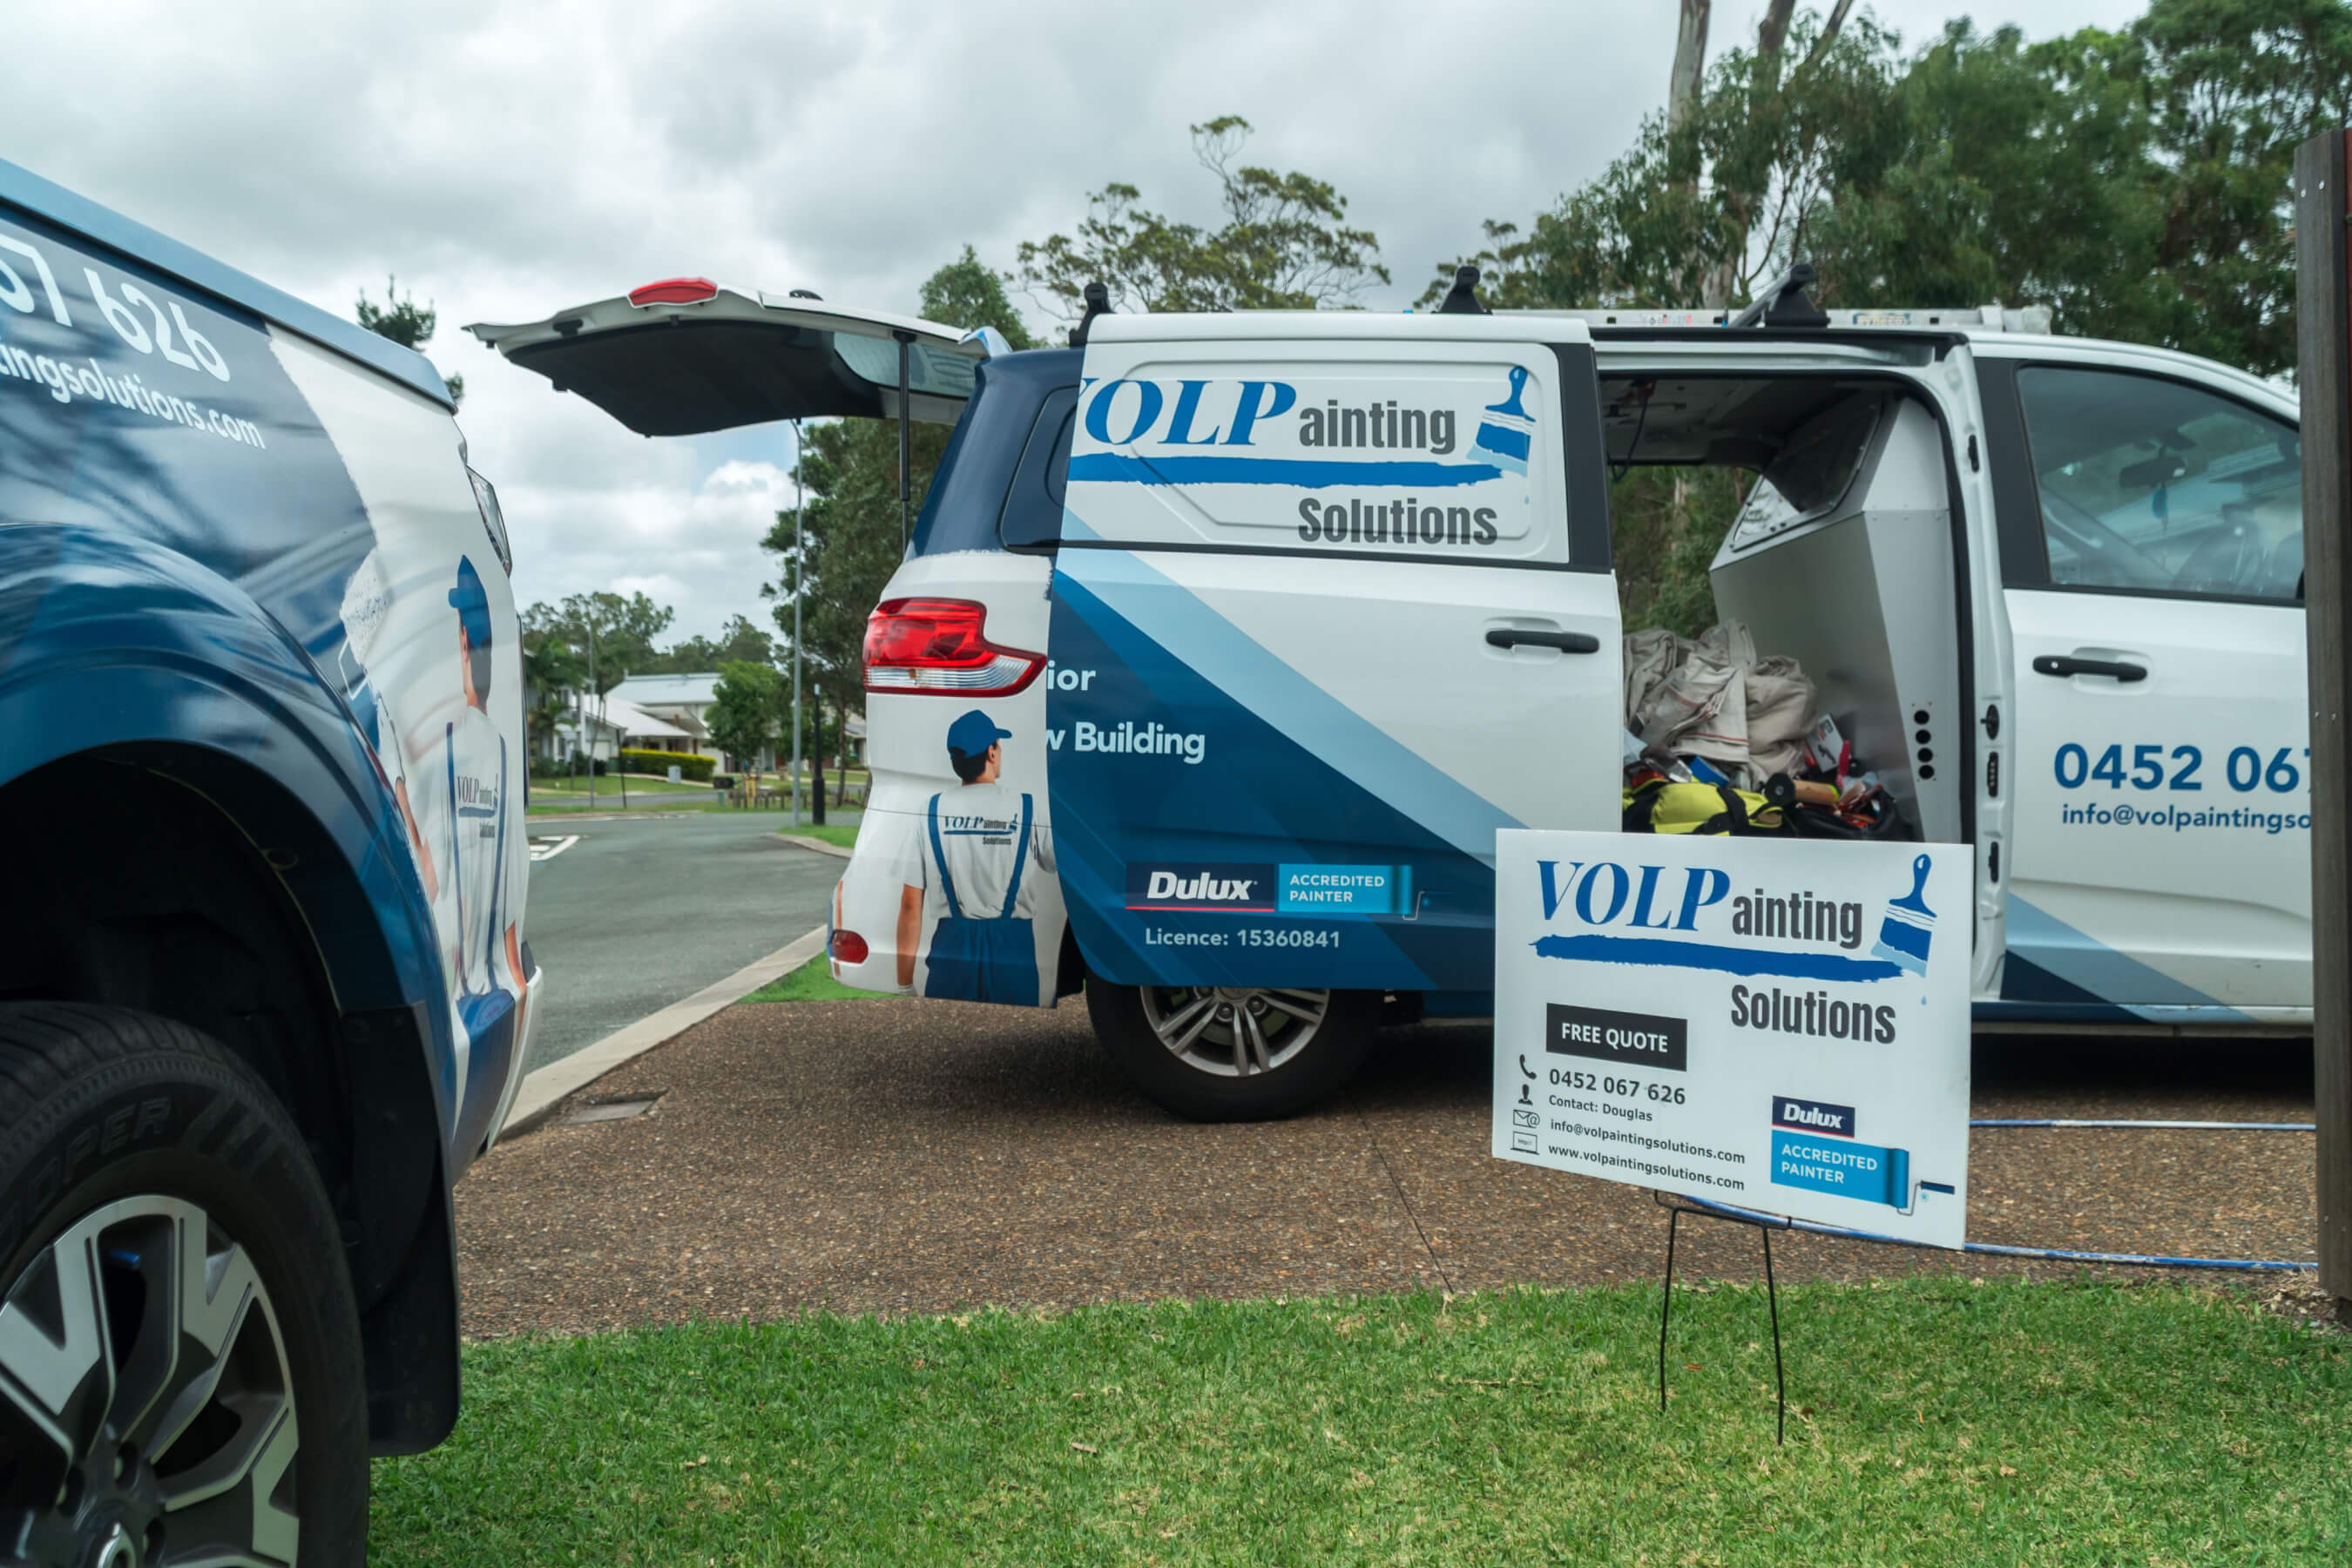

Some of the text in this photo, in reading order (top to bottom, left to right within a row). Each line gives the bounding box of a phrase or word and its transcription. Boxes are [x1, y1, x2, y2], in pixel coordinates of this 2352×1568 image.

[84, 267, 230, 382] 626
[1298, 497, 1498, 545] Solutions
[1047, 659, 1096, 691] ior
[1075, 721, 1206, 764] Building
[2054, 743, 2203, 791] 0452
[2062, 803, 2311, 835] info@volpaintingso
[1147, 871, 1253, 900] Dulux
[1289, 874, 1385, 888] ACCREDITED
[1289, 890, 1353, 902] PAINTER
[1145, 928, 1340, 948] Licence: 15360841
[1731, 984, 1896, 1044] Solutions
[1562, 1023, 1668, 1053] FREE QUOTE
[1549, 1068, 1686, 1105] 0452 067 626
[1549, 1095, 1652, 1121] Contact: Douglas
[1783, 1103, 1842, 1129] Dulux
[1551, 1119, 1745, 1165] info@volpaintingsolutions.com
[1781, 1144, 1877, 1171] ACCREDITED
[1548, 1143, 1745, 1191] www.volpaintingsolutions.com
[1781, 1161, 1844, 1184] PAINTER
